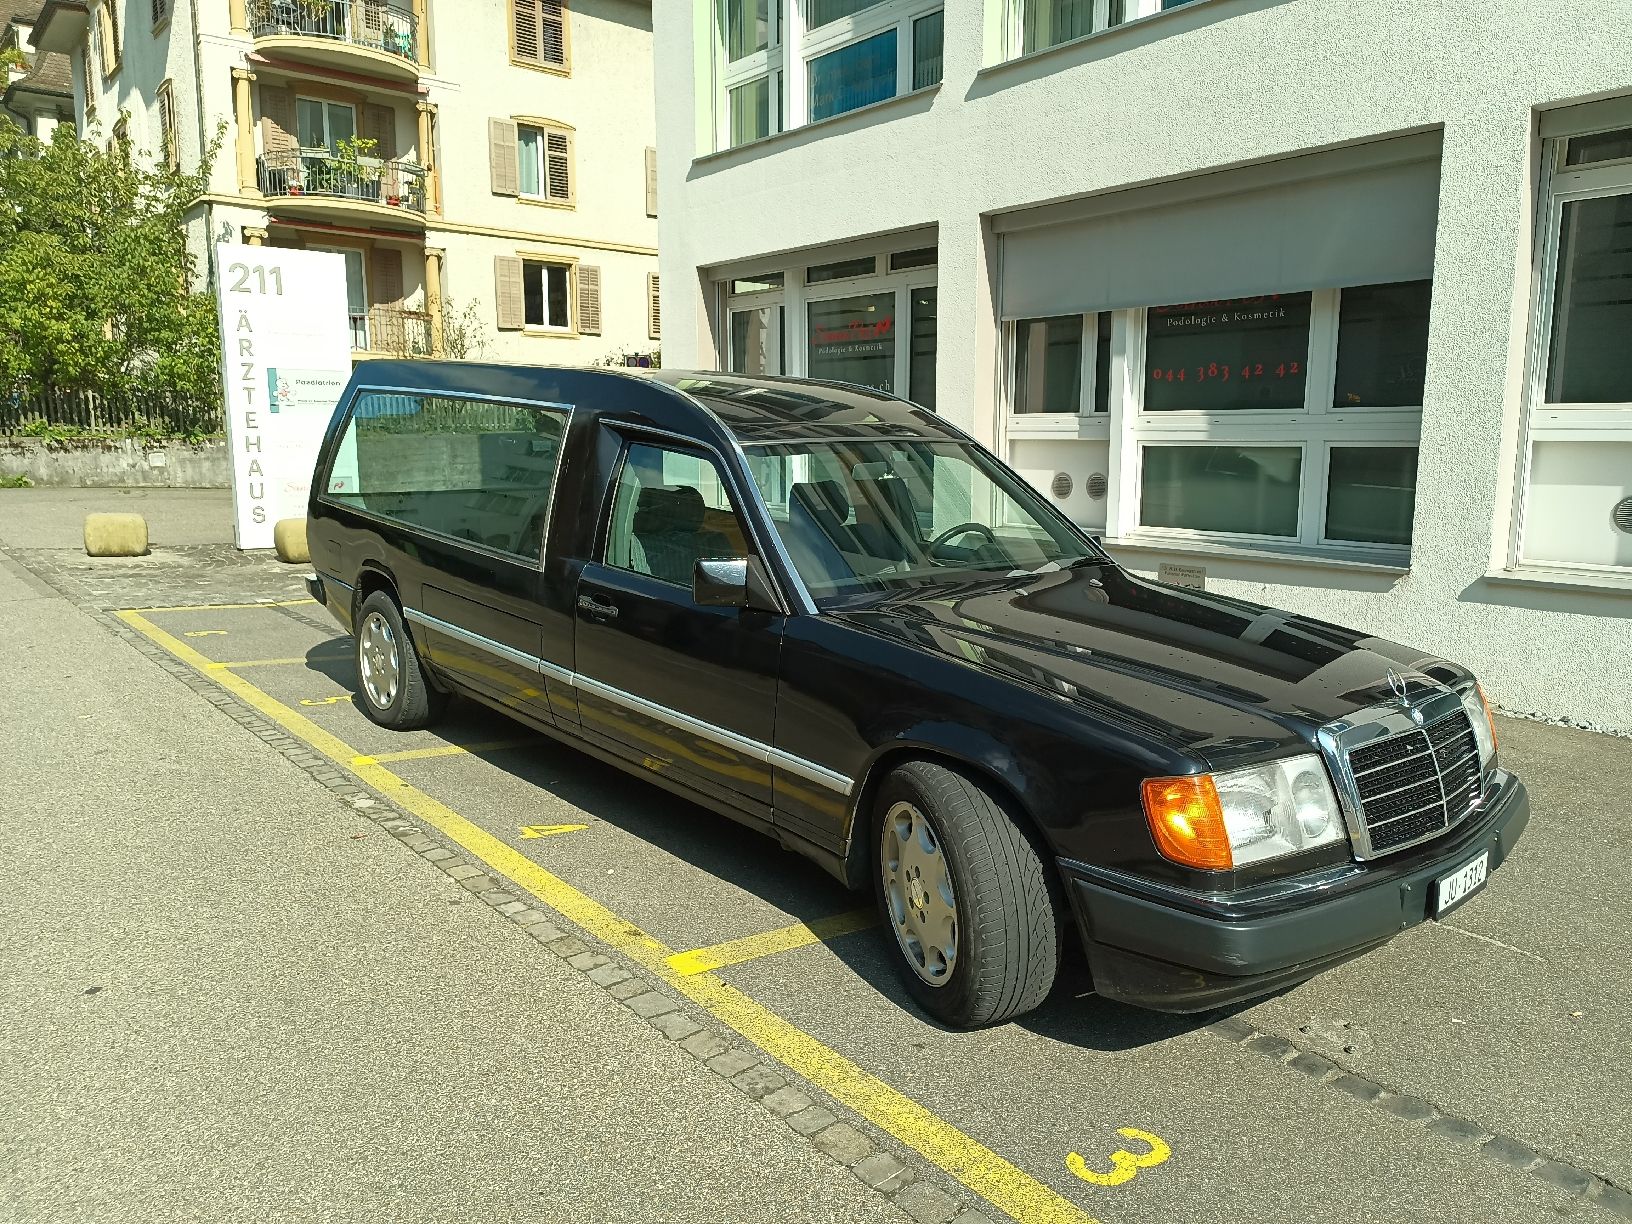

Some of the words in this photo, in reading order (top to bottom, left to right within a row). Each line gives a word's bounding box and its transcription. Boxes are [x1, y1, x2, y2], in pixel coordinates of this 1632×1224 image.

[228, 262, 282, 295] 211
[1167, 315, 1216, 327] Podologie
[1222, 313, 1229, 322] &
[1234, 308, 1285, 321] Kosmetik
[1153, 367, 1185, 382] 044
[1198, 362, 1230, 382] 383
[1241, 363, 1264, 380] 42
[1275, 361, 1300, 378] 42
[236, 309, 266, 524] ÄRZTEHAUS
[518, 823, 590, 840] 4
[1064, 1126, 1172, 1186] 3
